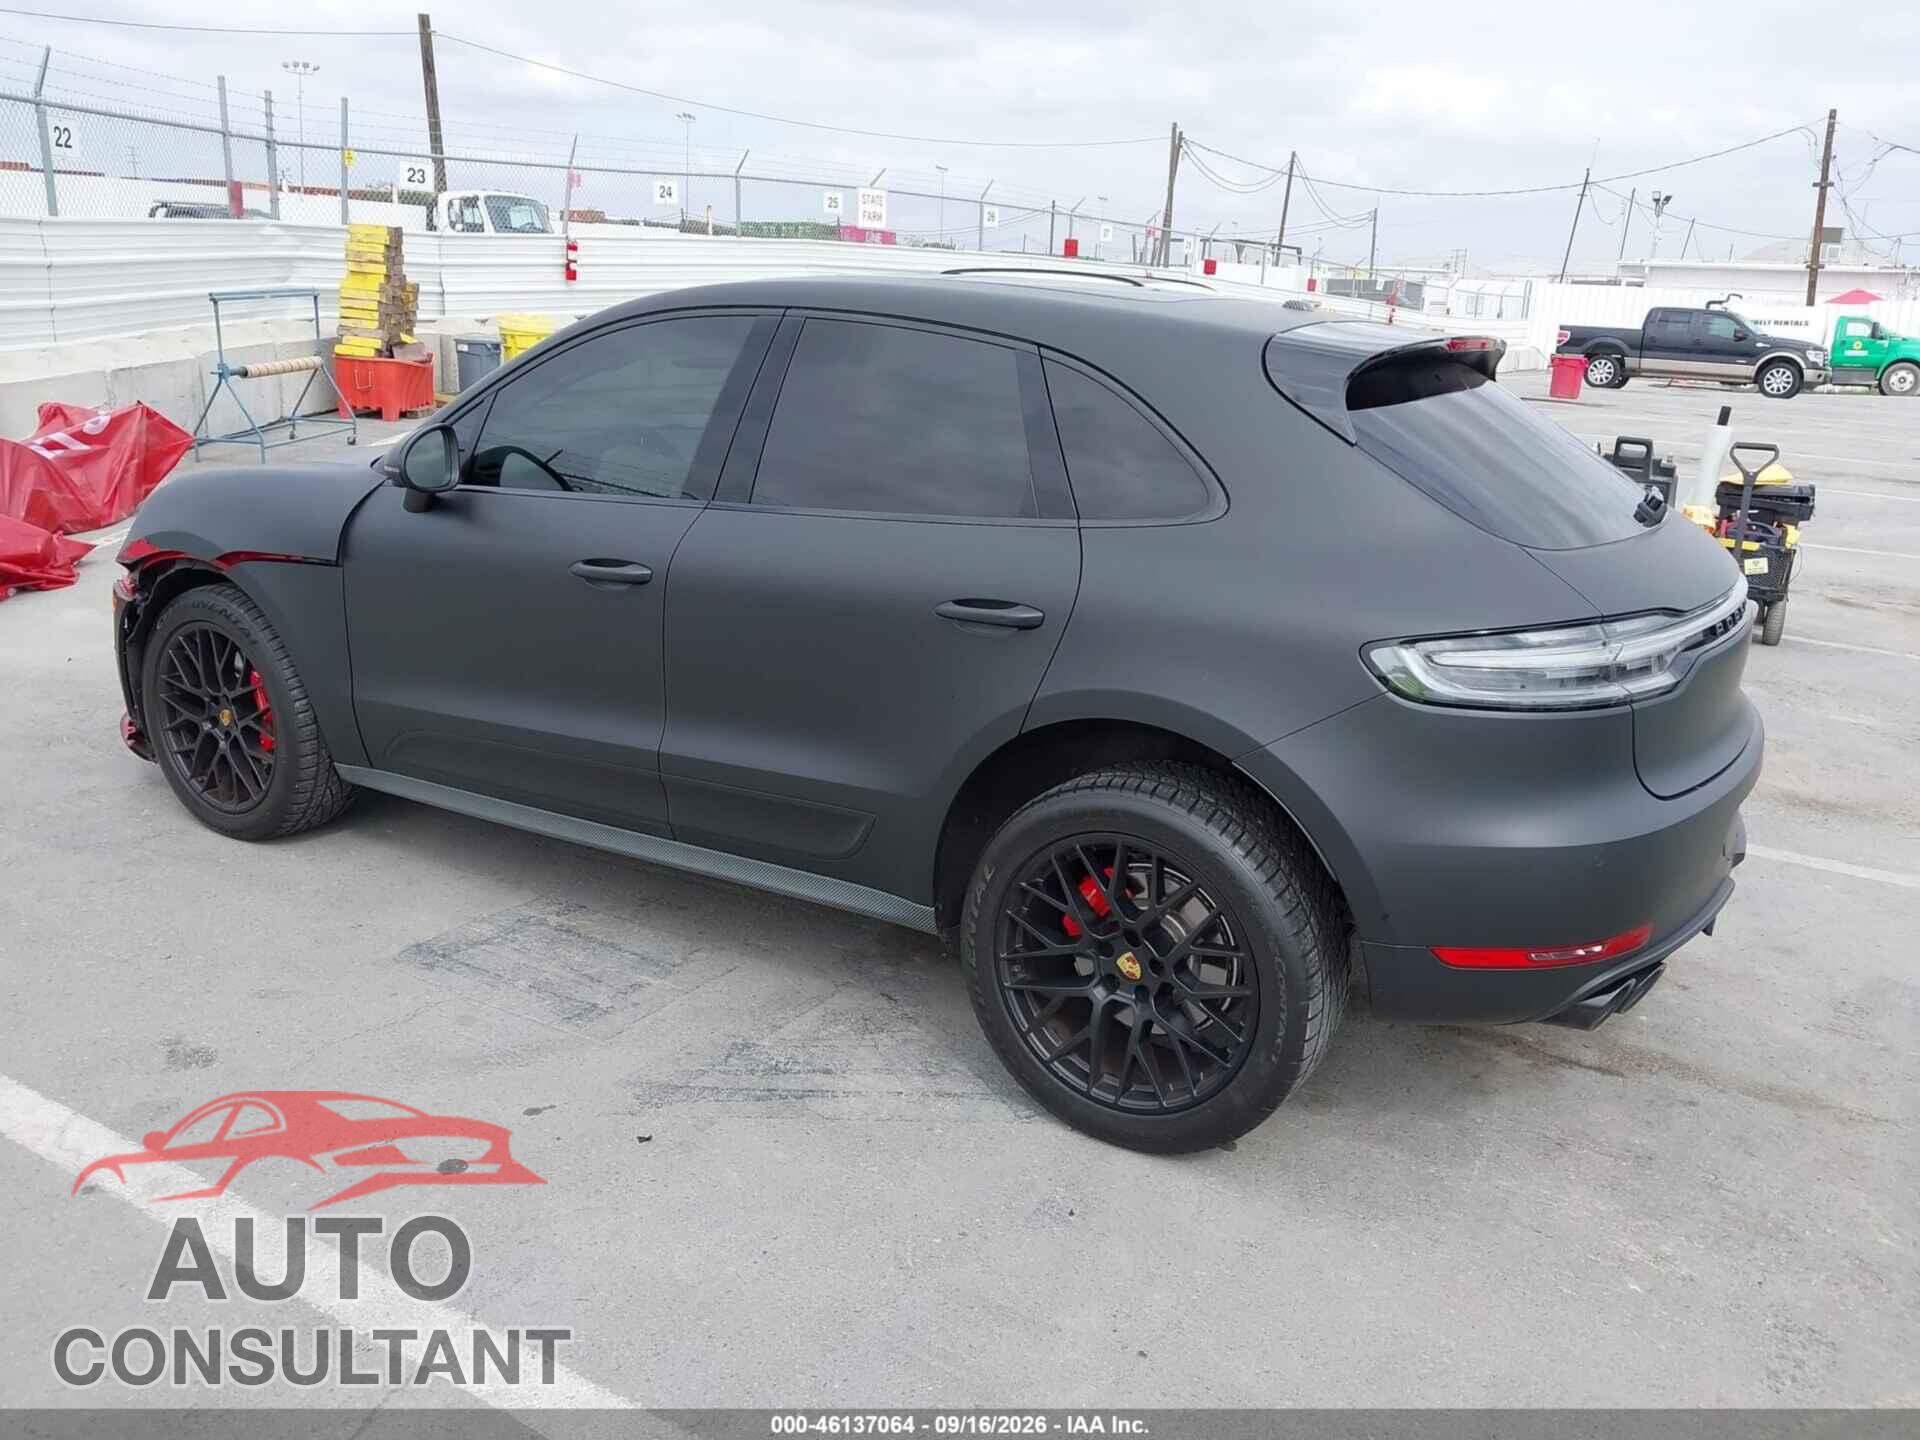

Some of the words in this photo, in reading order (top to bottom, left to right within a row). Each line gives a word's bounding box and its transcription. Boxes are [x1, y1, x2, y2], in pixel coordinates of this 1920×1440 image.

[53, 125, 73, 149] 22
[407, 167, 426, 184] 23
[659, 184, 673, 199] 24
[826, 195, 840, 209] 25
[861, 193, 884, 207] STATE
[862, 210, 883, 223] FARM
[1773, 319, 1809, 327] RENTALS
